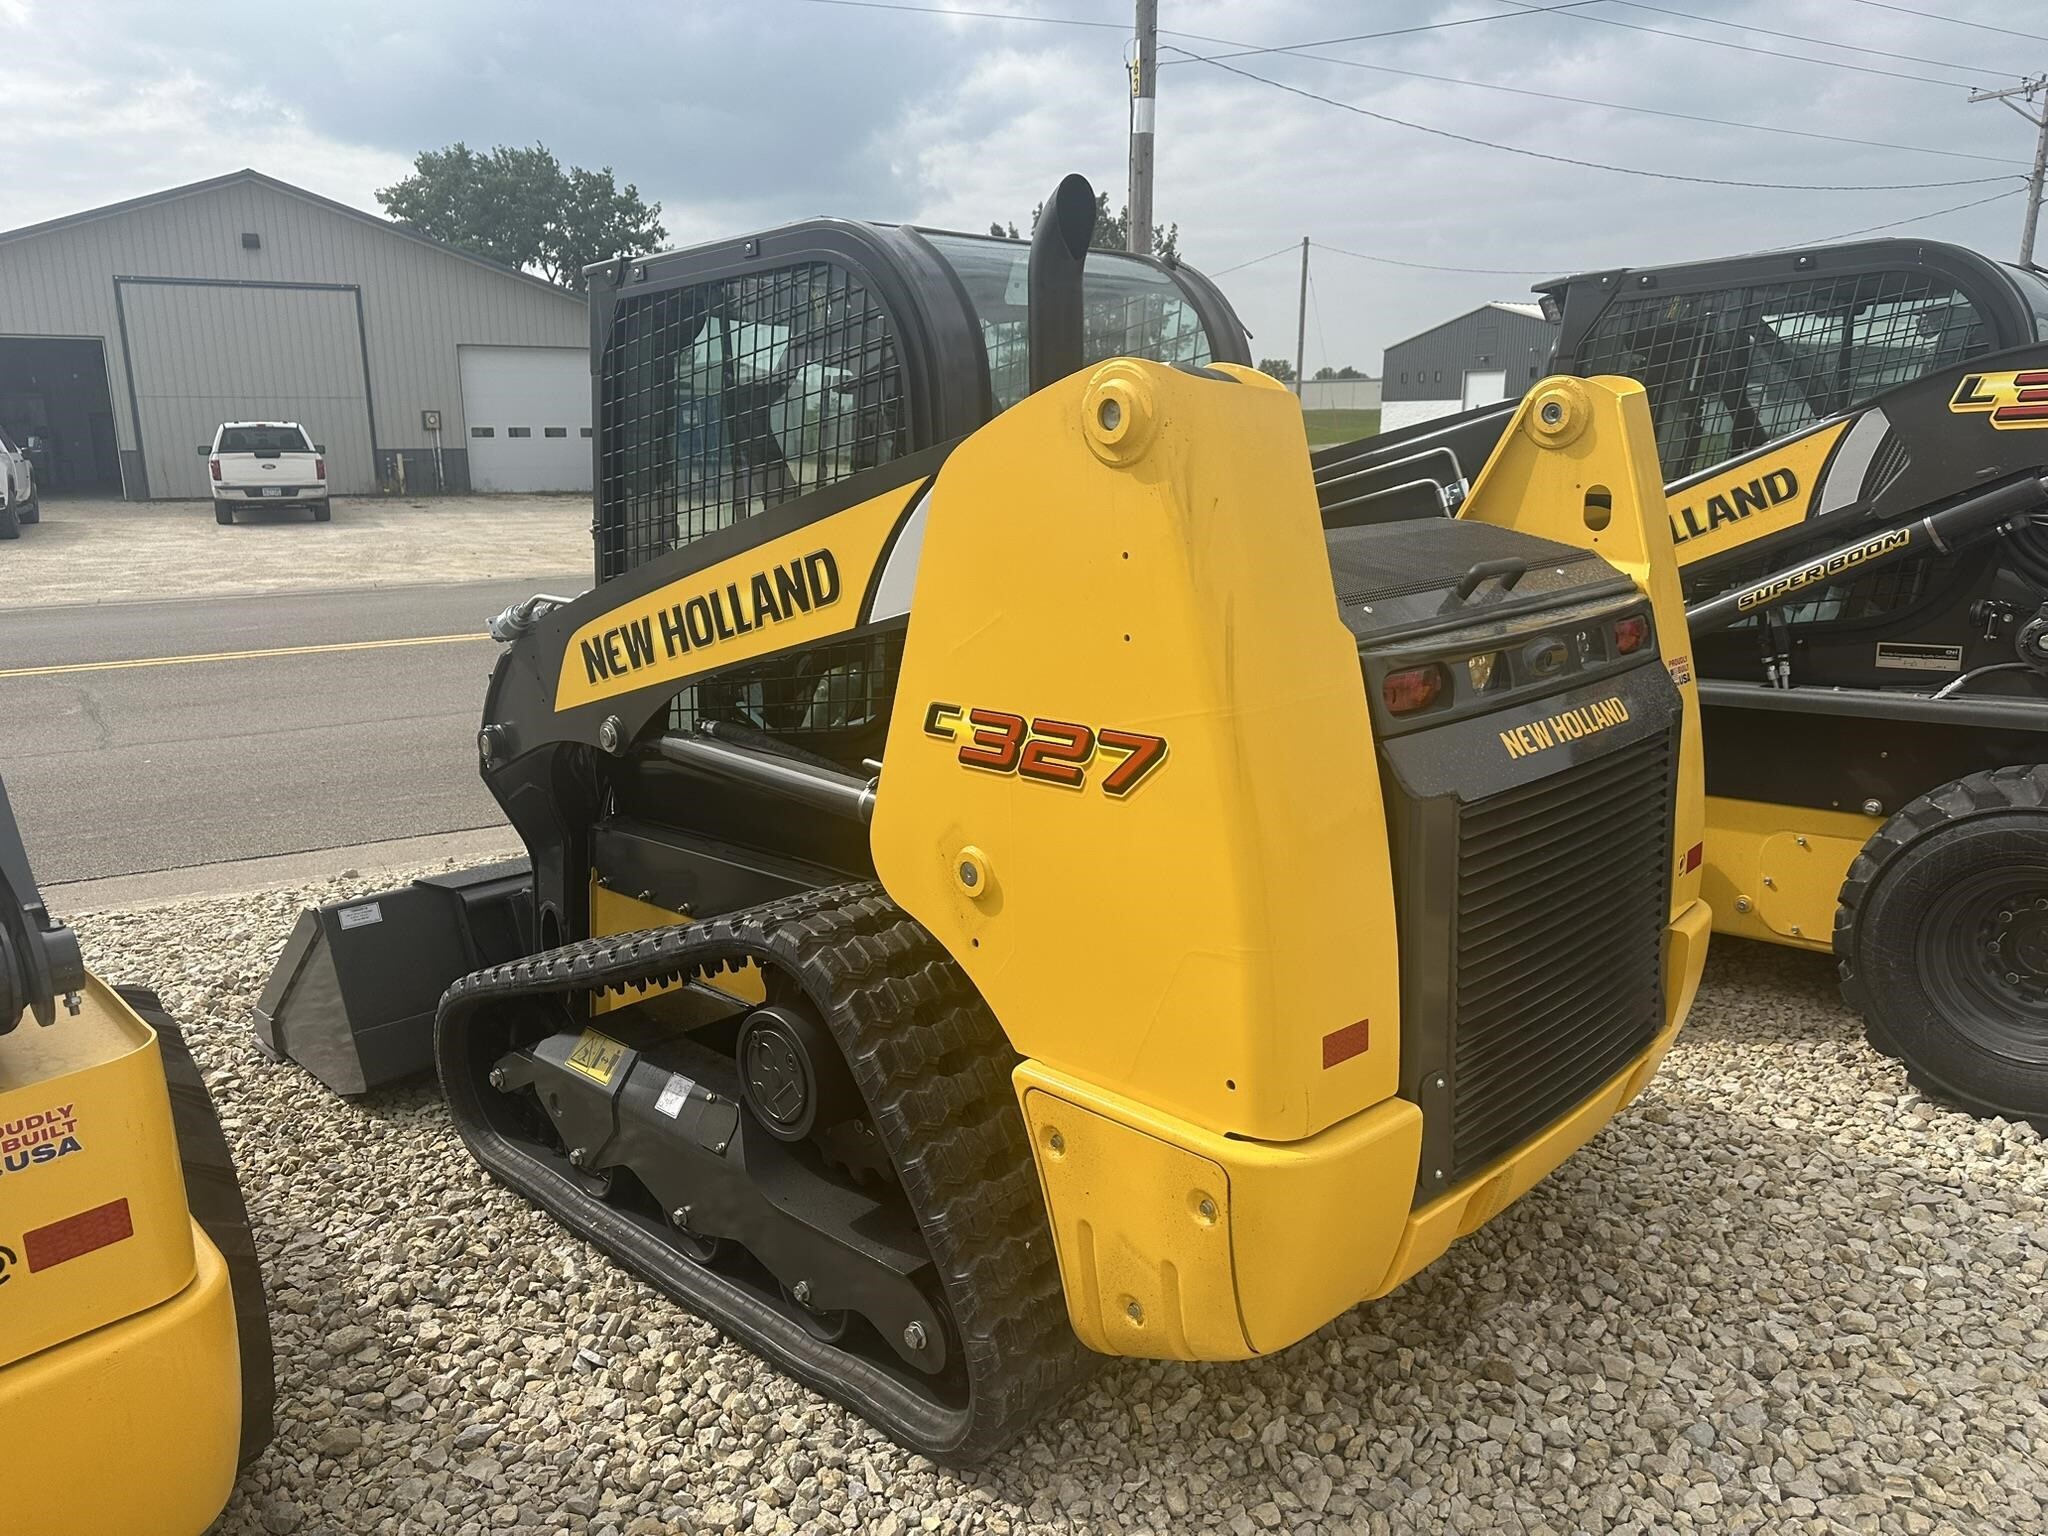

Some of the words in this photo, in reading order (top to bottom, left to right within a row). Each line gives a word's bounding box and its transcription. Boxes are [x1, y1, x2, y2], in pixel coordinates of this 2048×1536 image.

[1738, 564, 1825, 611] SUPER
[1827, 528, 1910, 574] BOOM
[580, 615, 656, 686] NEW
[657, 547, 841, 659] HOLLAND
[1499, 720, 1555, 759] NEW
[1548, 696, 1630, 743] HOLLAND
[1, 1119, 77, 1153] BUILT
[4, 1136, 82, 1172] USA
